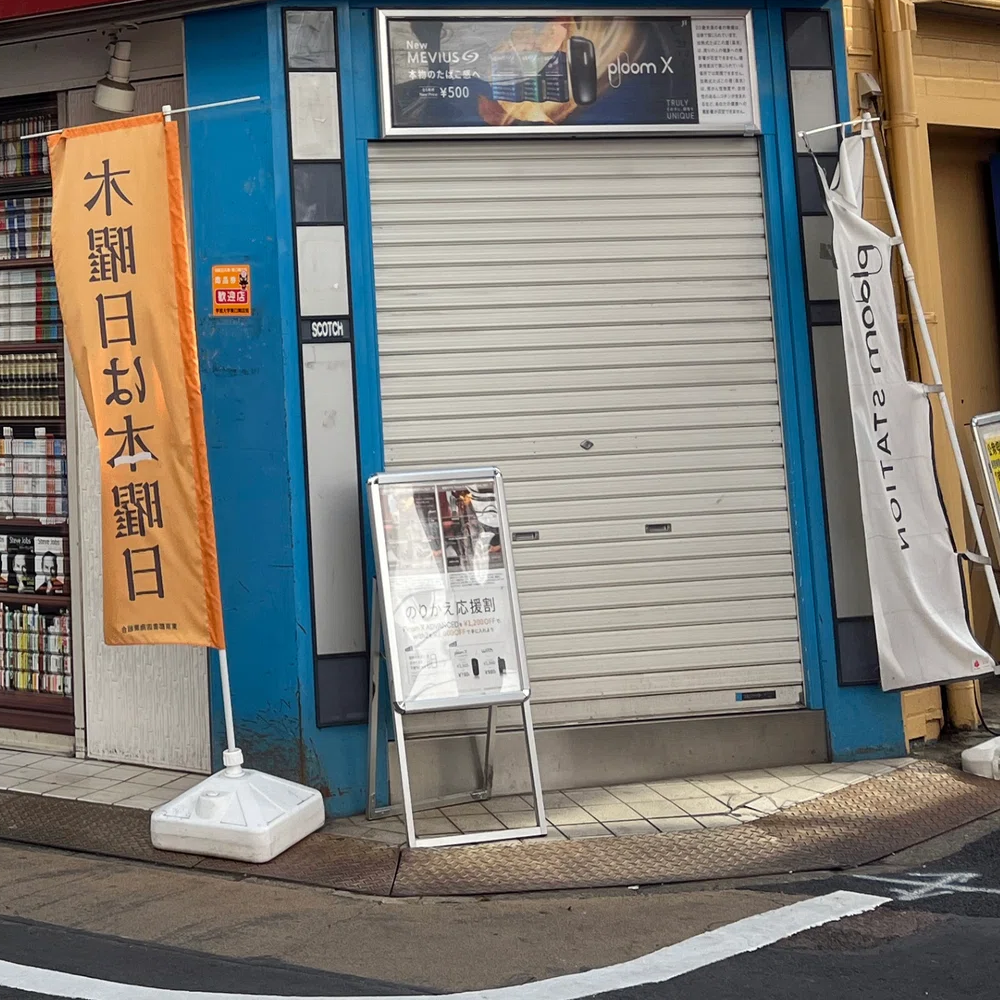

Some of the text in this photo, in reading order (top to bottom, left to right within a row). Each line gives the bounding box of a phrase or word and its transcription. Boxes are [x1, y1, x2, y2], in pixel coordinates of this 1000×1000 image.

[406, 40, 428, 50] New
[407, 51, 460, 64] MEVIUS
[408, 69, 481, 80] 本物のたばこ感へ
[608, 53, 674, 88] ploom X
[440, 86, 470, 98] ¥500
[666, 99, 689, 107] TRULY
[667, 112, 695, 120] UNIQUE
[312, 321, 344, 337] SCOTCH
